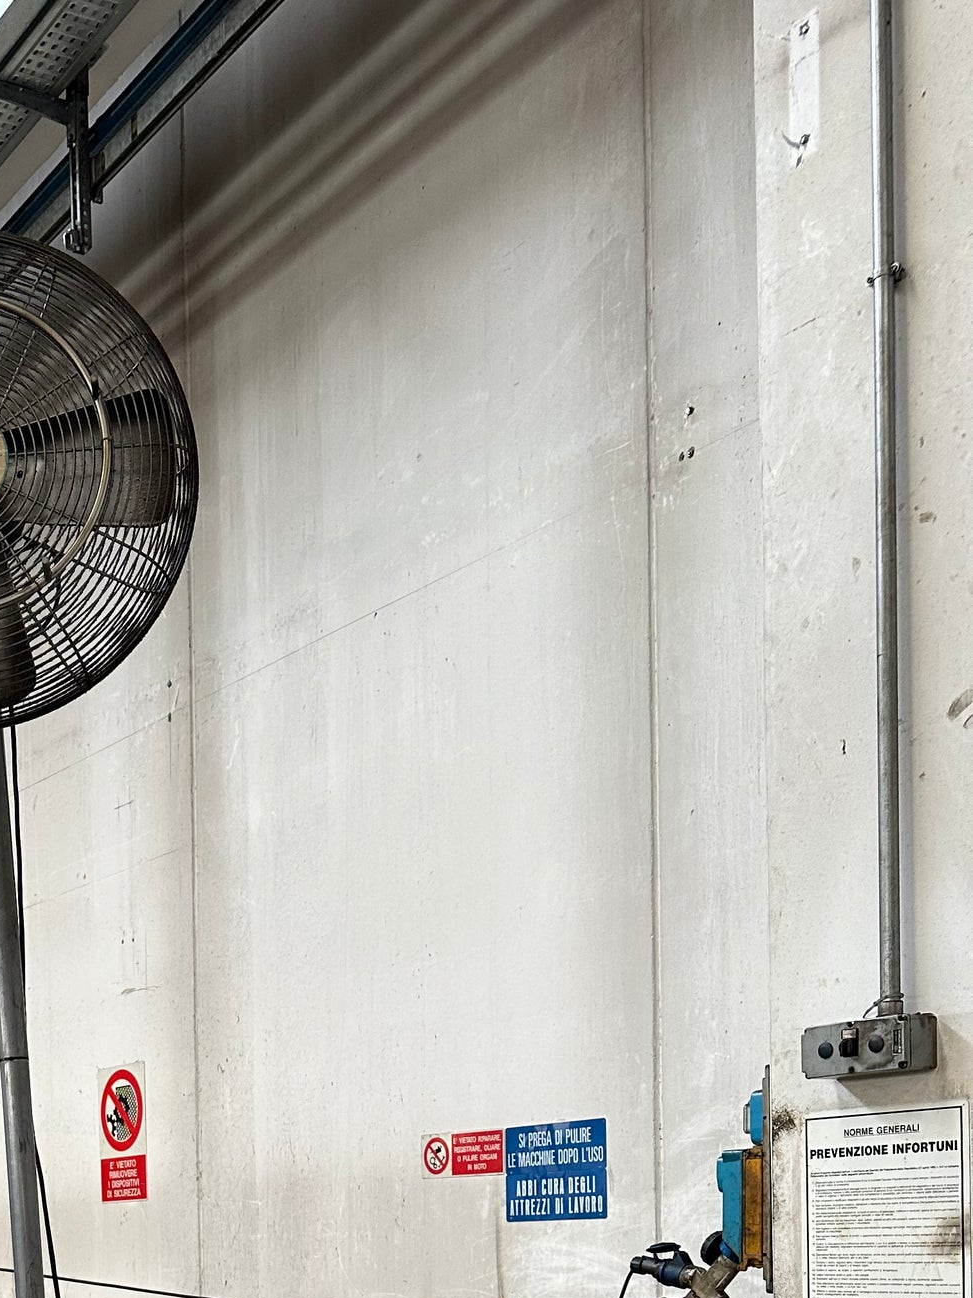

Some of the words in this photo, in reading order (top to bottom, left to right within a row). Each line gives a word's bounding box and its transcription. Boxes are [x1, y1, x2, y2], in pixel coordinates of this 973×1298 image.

[518, 1133, 526, 1148] SI
[528, 1130, 552, 1148] PREGA
[554, 1129, 562, 1146] DI
[566, 1126, 592, 1144] PULIRE
[843, 1127, 874, 1137] NORME
[876, 1124, 920, 1135] GENERALI
[508, 1153, 516, 1168] LE
[518, 1150, 556, 1168] MACCHINE
[558, 1148, 579, 1164] DOPO
[582, 1146, 604, 1162] L'USO
[810, 1144, 888, 1160] PREVENZIONE
[892, 1140, 958, 1155] INFORTUNI
[107, 1190, 112, 1198] DI
[114, 1188, 141, 1198] SICUREZZA
[516, 1179, 537, 1197] ABBI
[541, 1178, 564, 1196] CURA
[568, 1176, 596, 1194] DEGLI
[510, 1198, 550, 1216] ATTREZZI
[555, 1197, 564, 1214] DI
[568, 1195, 603, 1214] LAVORO
